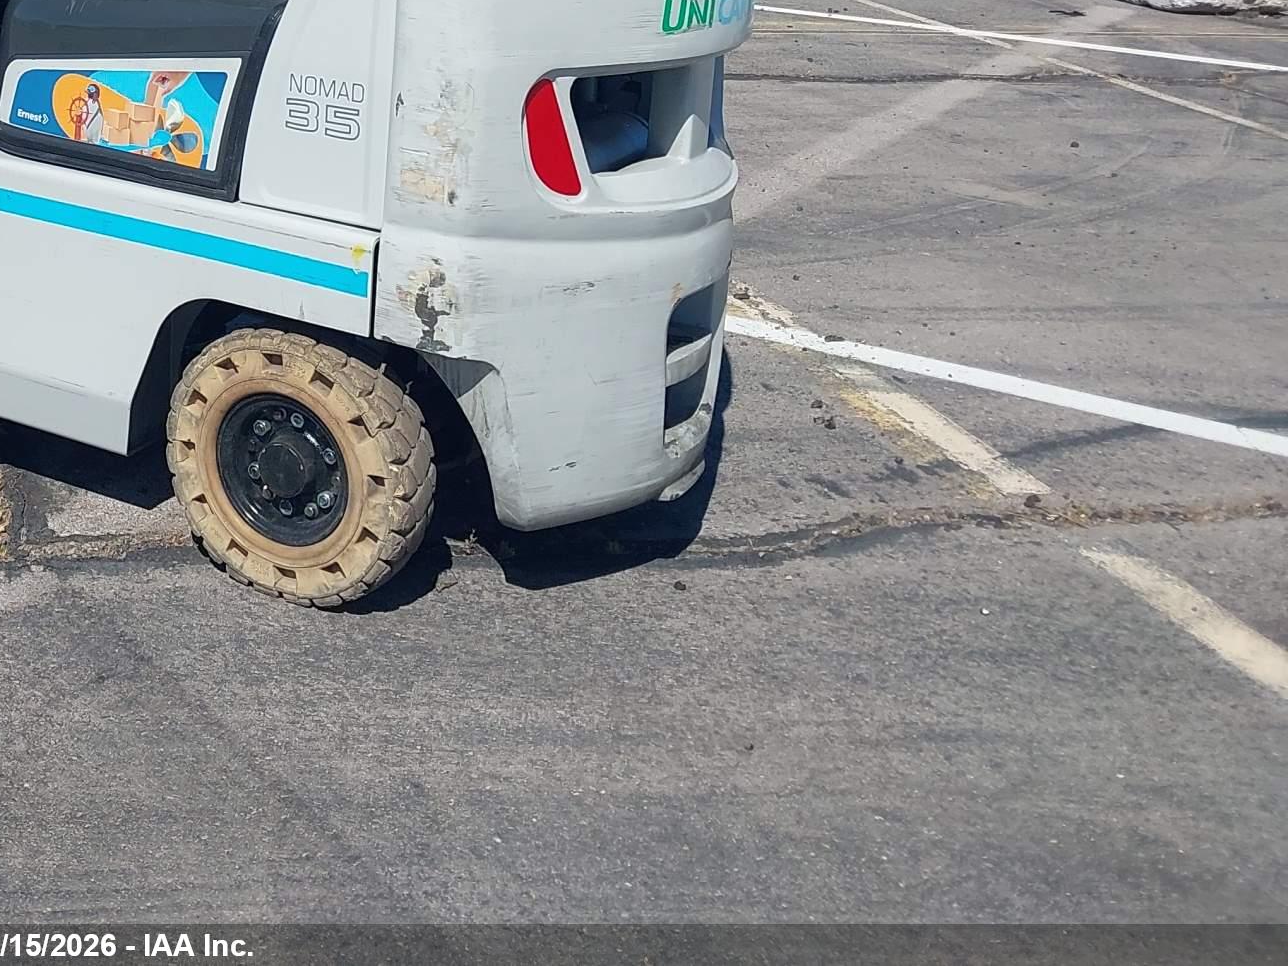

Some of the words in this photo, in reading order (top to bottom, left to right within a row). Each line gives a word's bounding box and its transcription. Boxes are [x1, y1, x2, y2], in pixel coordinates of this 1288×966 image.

[289, 73, 365, 104] NOMAD
[17, 108, 43, 124] Ernest
[285, 97, 361, 141] 35
